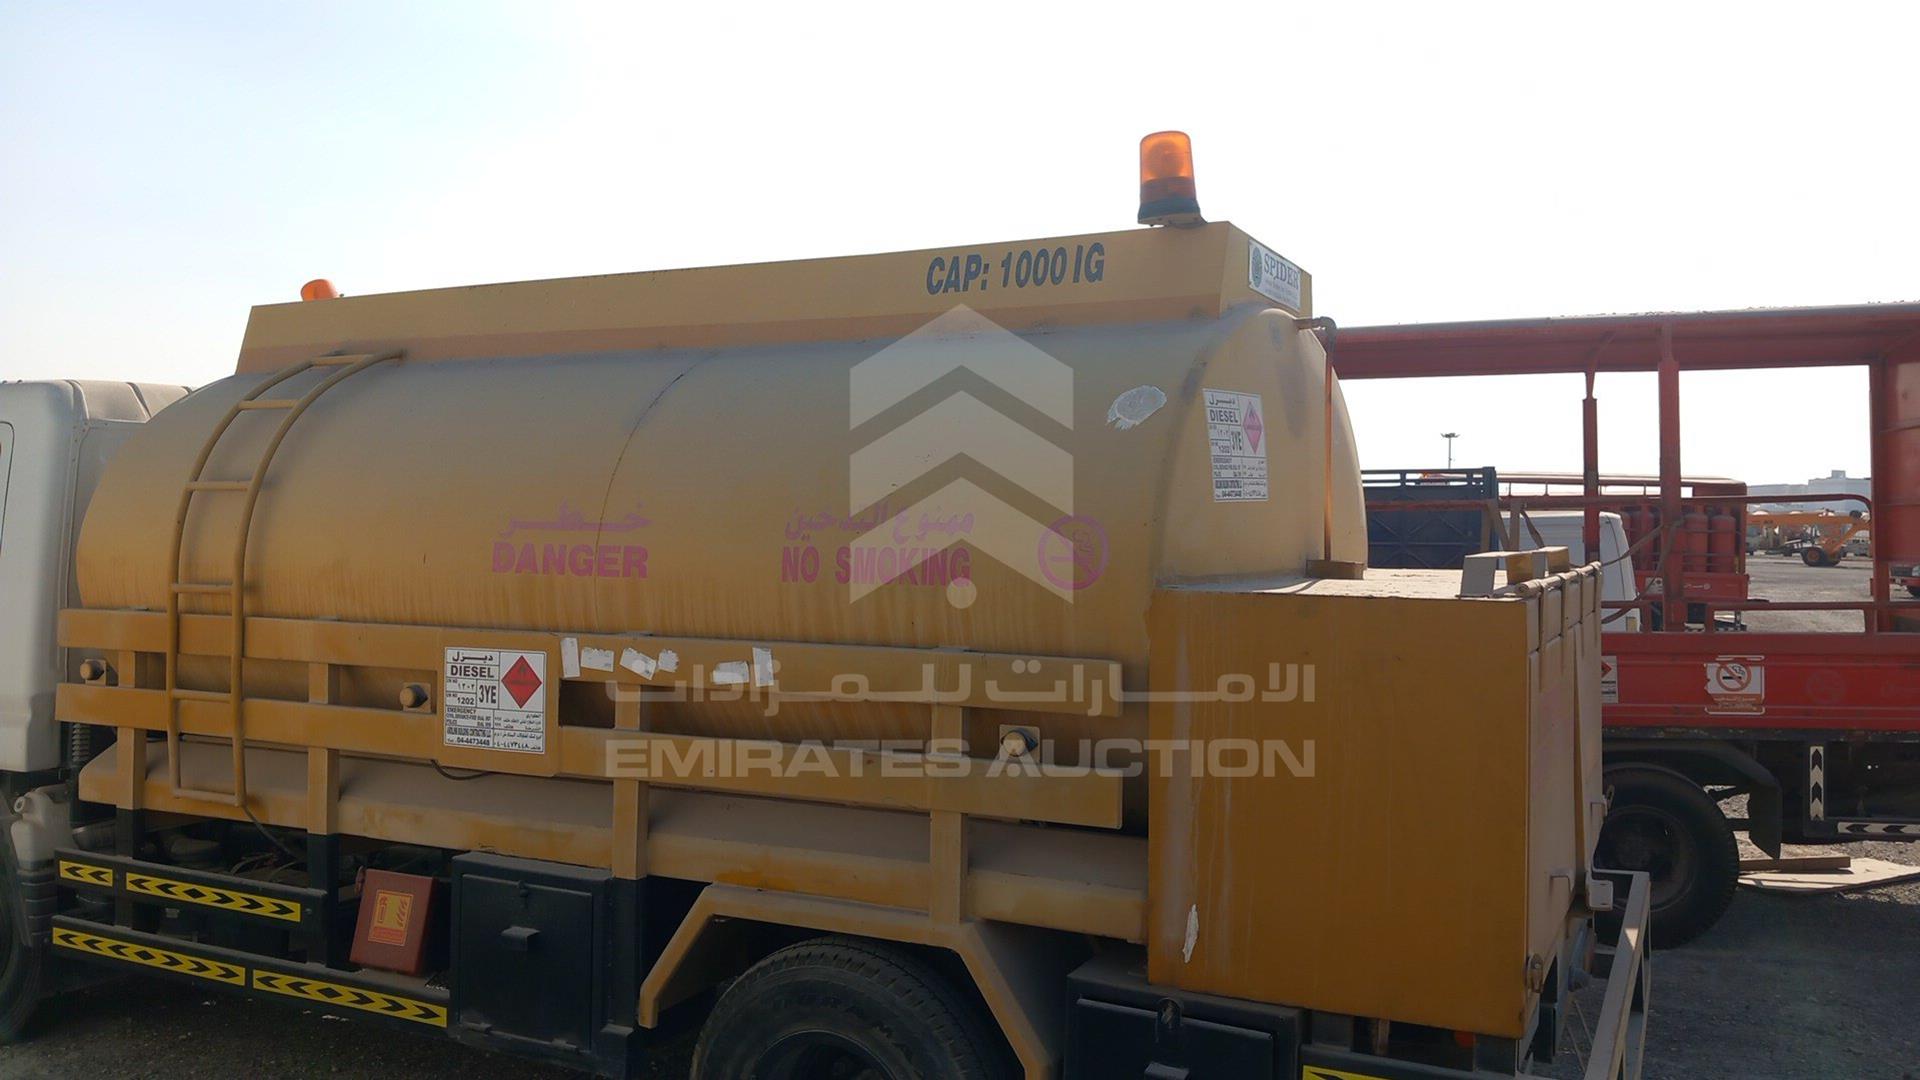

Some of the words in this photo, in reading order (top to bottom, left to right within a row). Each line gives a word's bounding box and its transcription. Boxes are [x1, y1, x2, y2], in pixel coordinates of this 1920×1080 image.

[926, 251, 990, 296] CAP:
[1000, 246, 1068, 289] 1000
[1263, 252, 1299, 290] SPIDER
[1209, 409, 1239, 424] DIESEL
[492, 541, 649, 579] DANGER
[781, 546, 821, 584] NO
[834, 546, 971, 587] SMOKING
[452, 651, 494, 664] ديزل
[450, 665, 494, 679] DIESEL
[457, 696, 475, 705] 1202
[478, 684, 497, 704] 3YE
